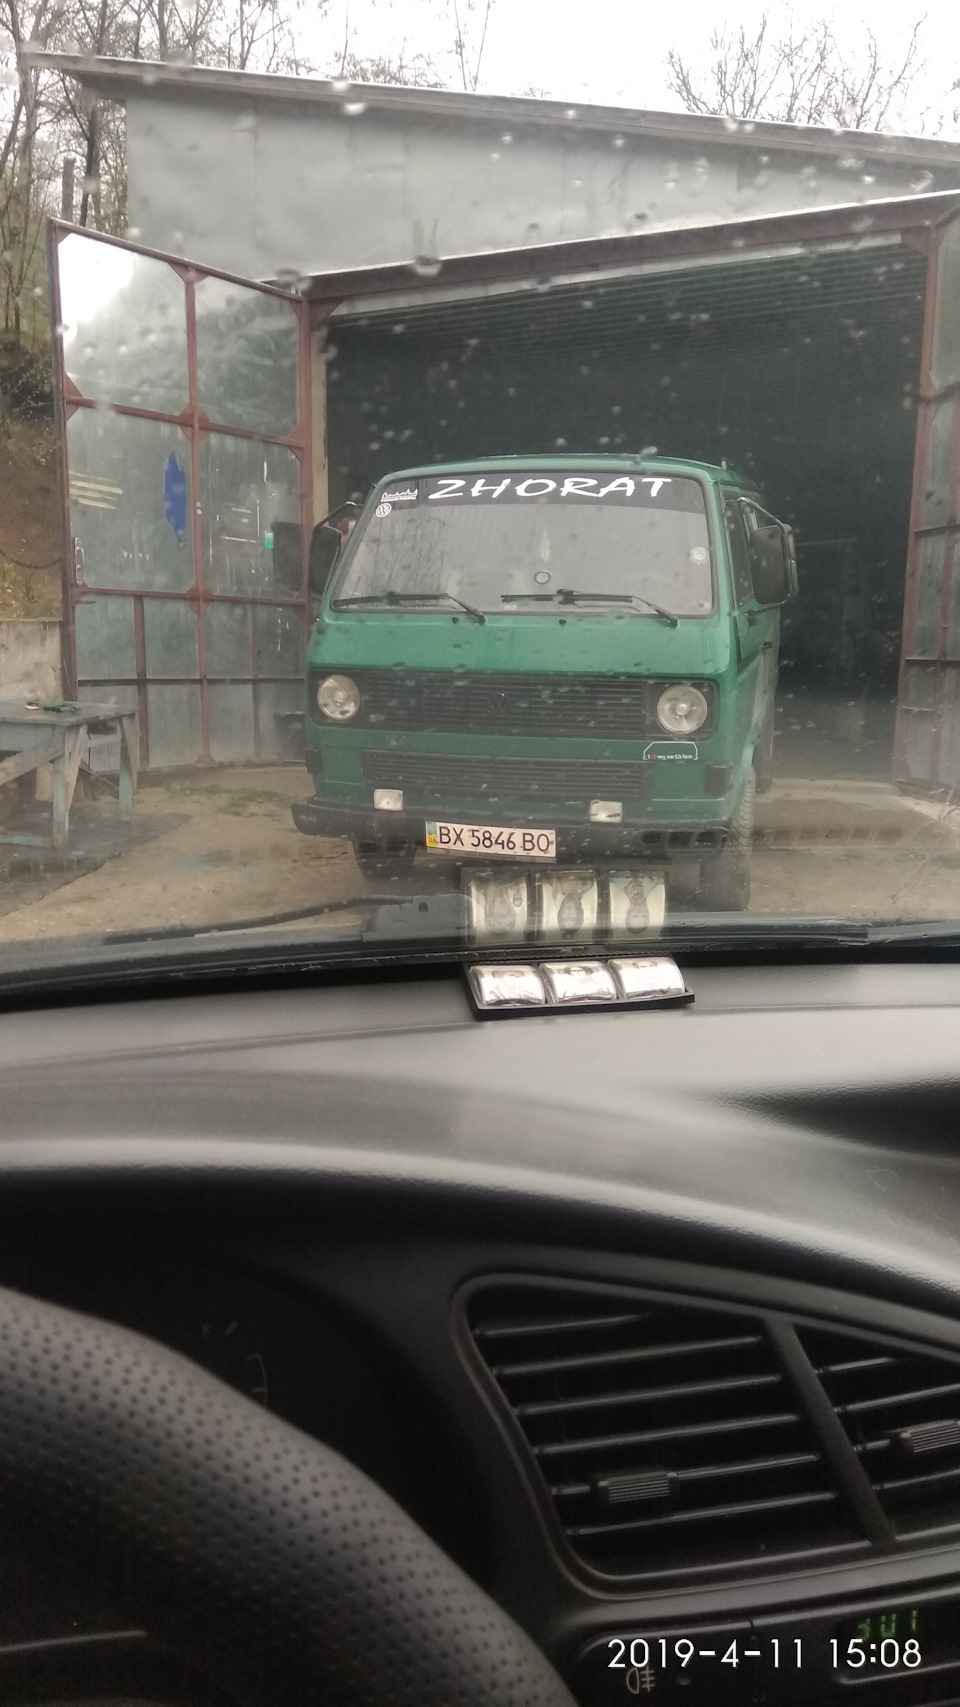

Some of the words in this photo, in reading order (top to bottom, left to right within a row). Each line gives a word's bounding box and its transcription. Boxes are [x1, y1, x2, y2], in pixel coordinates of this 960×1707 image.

[428, 477, 672, 499] ZHORAT
[438, 826, 465, 847] BX
[470, 829, 516, 850] 5846
[522, 832, 550, 852] BO
